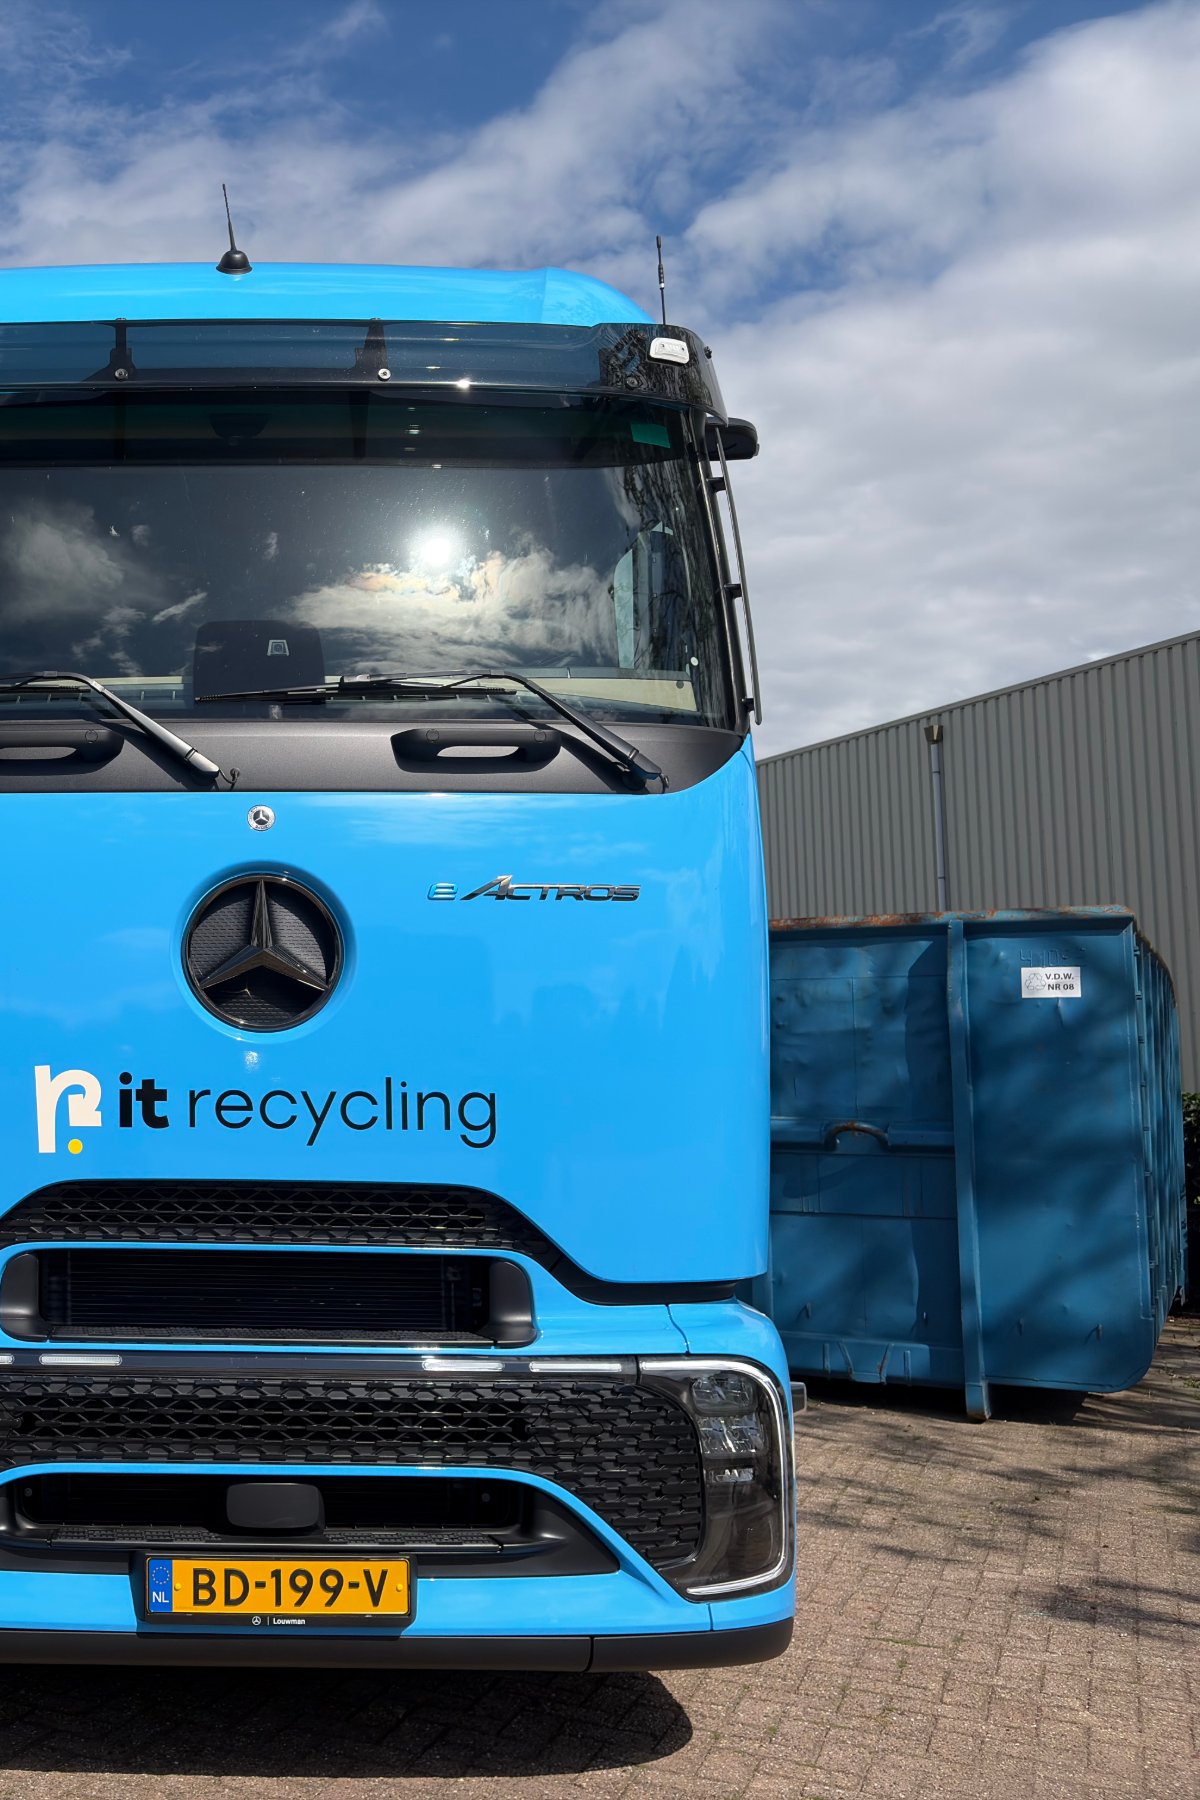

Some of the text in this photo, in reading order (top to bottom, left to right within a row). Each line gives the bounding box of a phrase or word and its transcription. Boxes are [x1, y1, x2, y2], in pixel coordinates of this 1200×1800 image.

[1045, 972, 1075, 981] V.D.W.
[1047, 983, 1075, 991] NR 08
[118, 1071, 498, 1149] it recycling
[192, 1567, 389, 1608] BD-199-V
[152, 1591, 170, 1604] NL
[272, 1616, 306, 1626] Louwman
